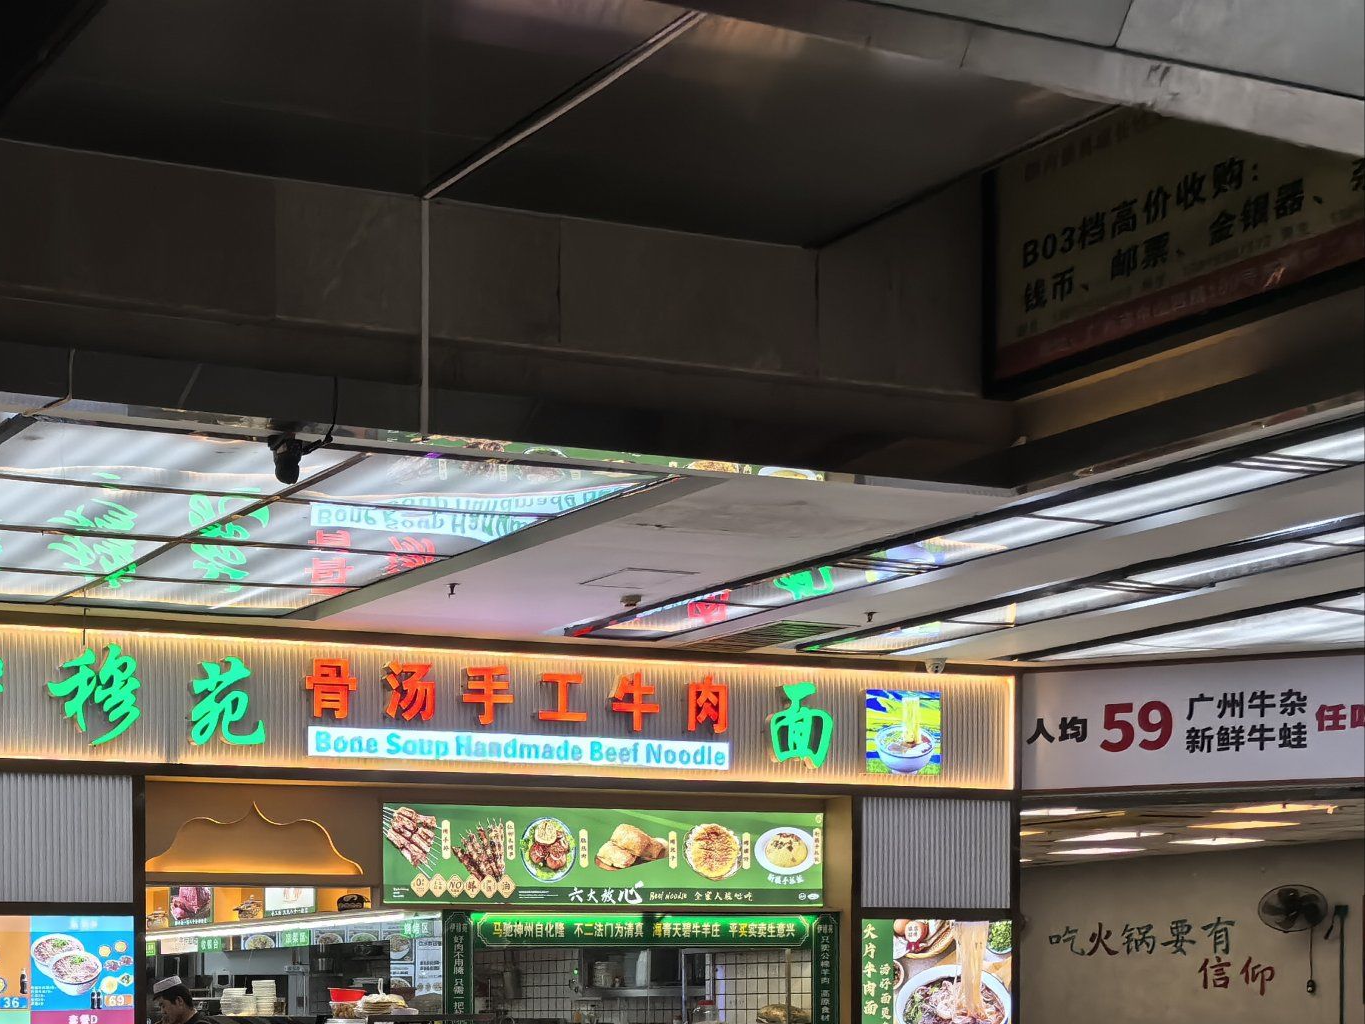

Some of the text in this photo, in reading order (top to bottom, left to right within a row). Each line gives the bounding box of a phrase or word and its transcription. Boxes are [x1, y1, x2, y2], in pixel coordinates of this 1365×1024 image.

[305, 658, 729, 735] 骨汤手工牛肉
[1185, 688, 1308, 722] 广州牛杂
[1026, 700, 1174, 752] 人均 59
[1185, 722, 1308, 754] 新鲜牛蛙
[315, 730, 726, 768] Bone Soup Handmade Beef Noodle
[568, 881, 645, 905] 六大放心
[1048, 915, 1236, 957] 吃火锅要有
[863, 923, 879, 1016] 大片牛肉面
[1197, 955, 1276, 996] 信仰
[3, 997, 20, 1009] 36
[108, 995, 125, 1006] 69
